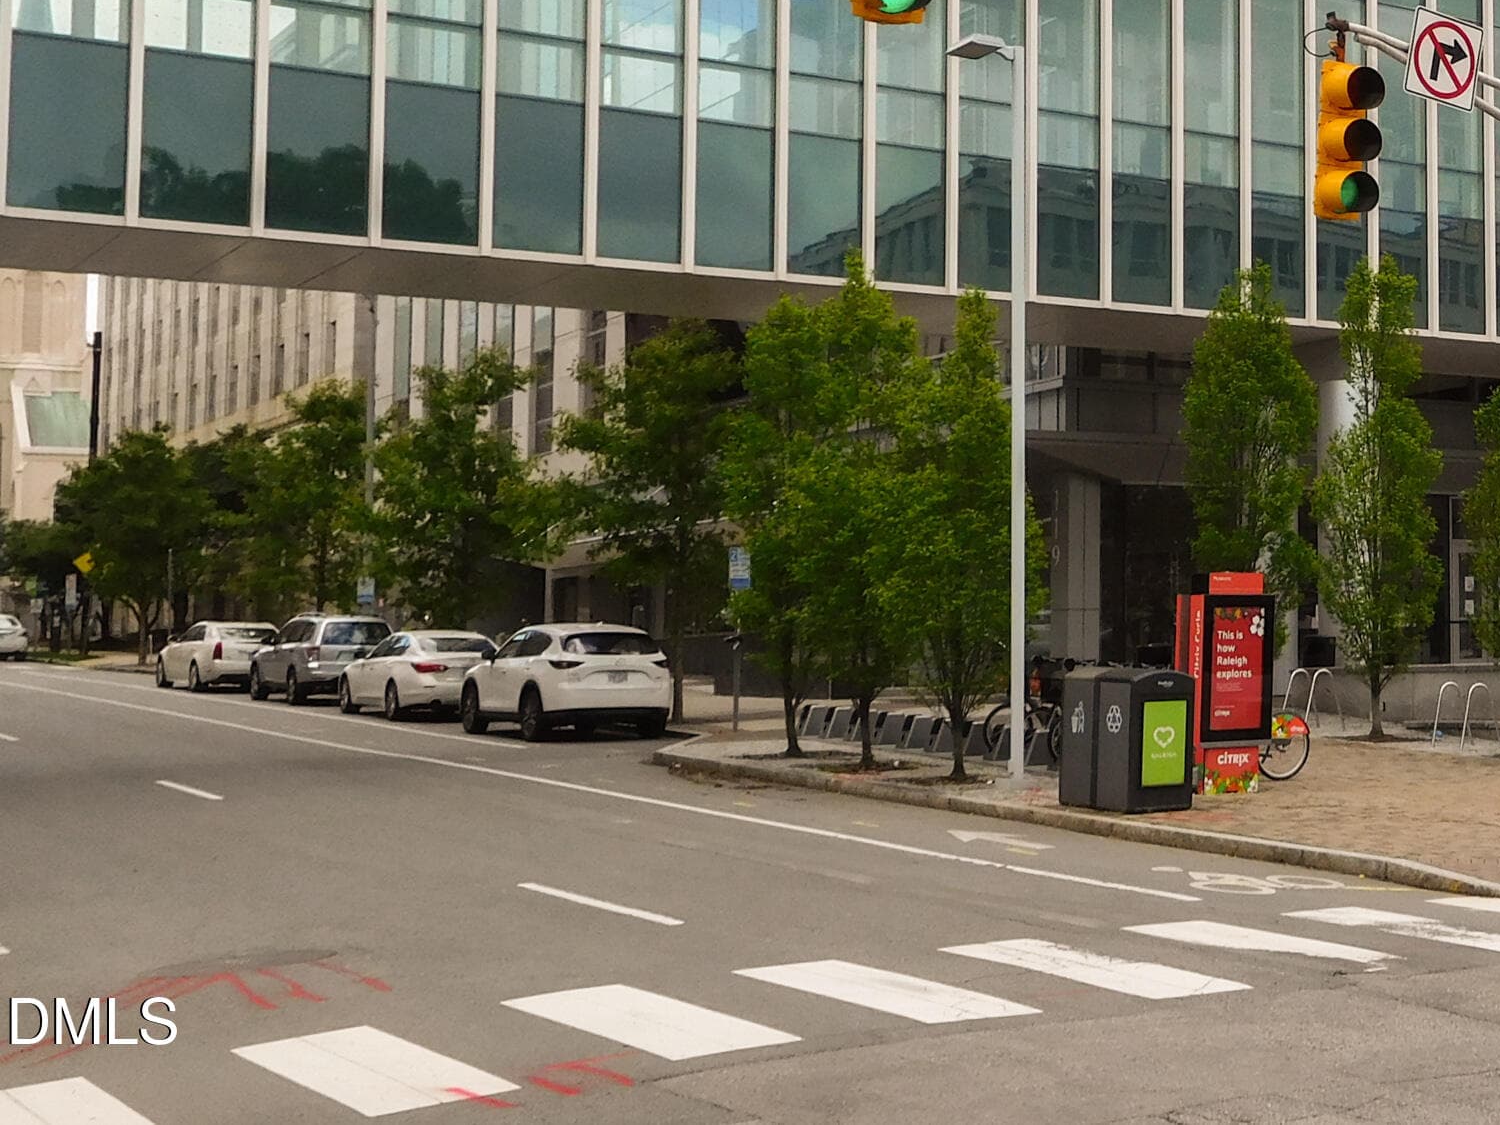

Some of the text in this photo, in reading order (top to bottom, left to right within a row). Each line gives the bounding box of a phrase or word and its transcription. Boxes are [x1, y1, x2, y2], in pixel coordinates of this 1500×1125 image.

[1217, 630, 1244, 640] This is
[1216, 643, 1236, 652] how
[1216, 655, 1248, 667] Raleigh
[1216, 669, 1252, 680] explores
